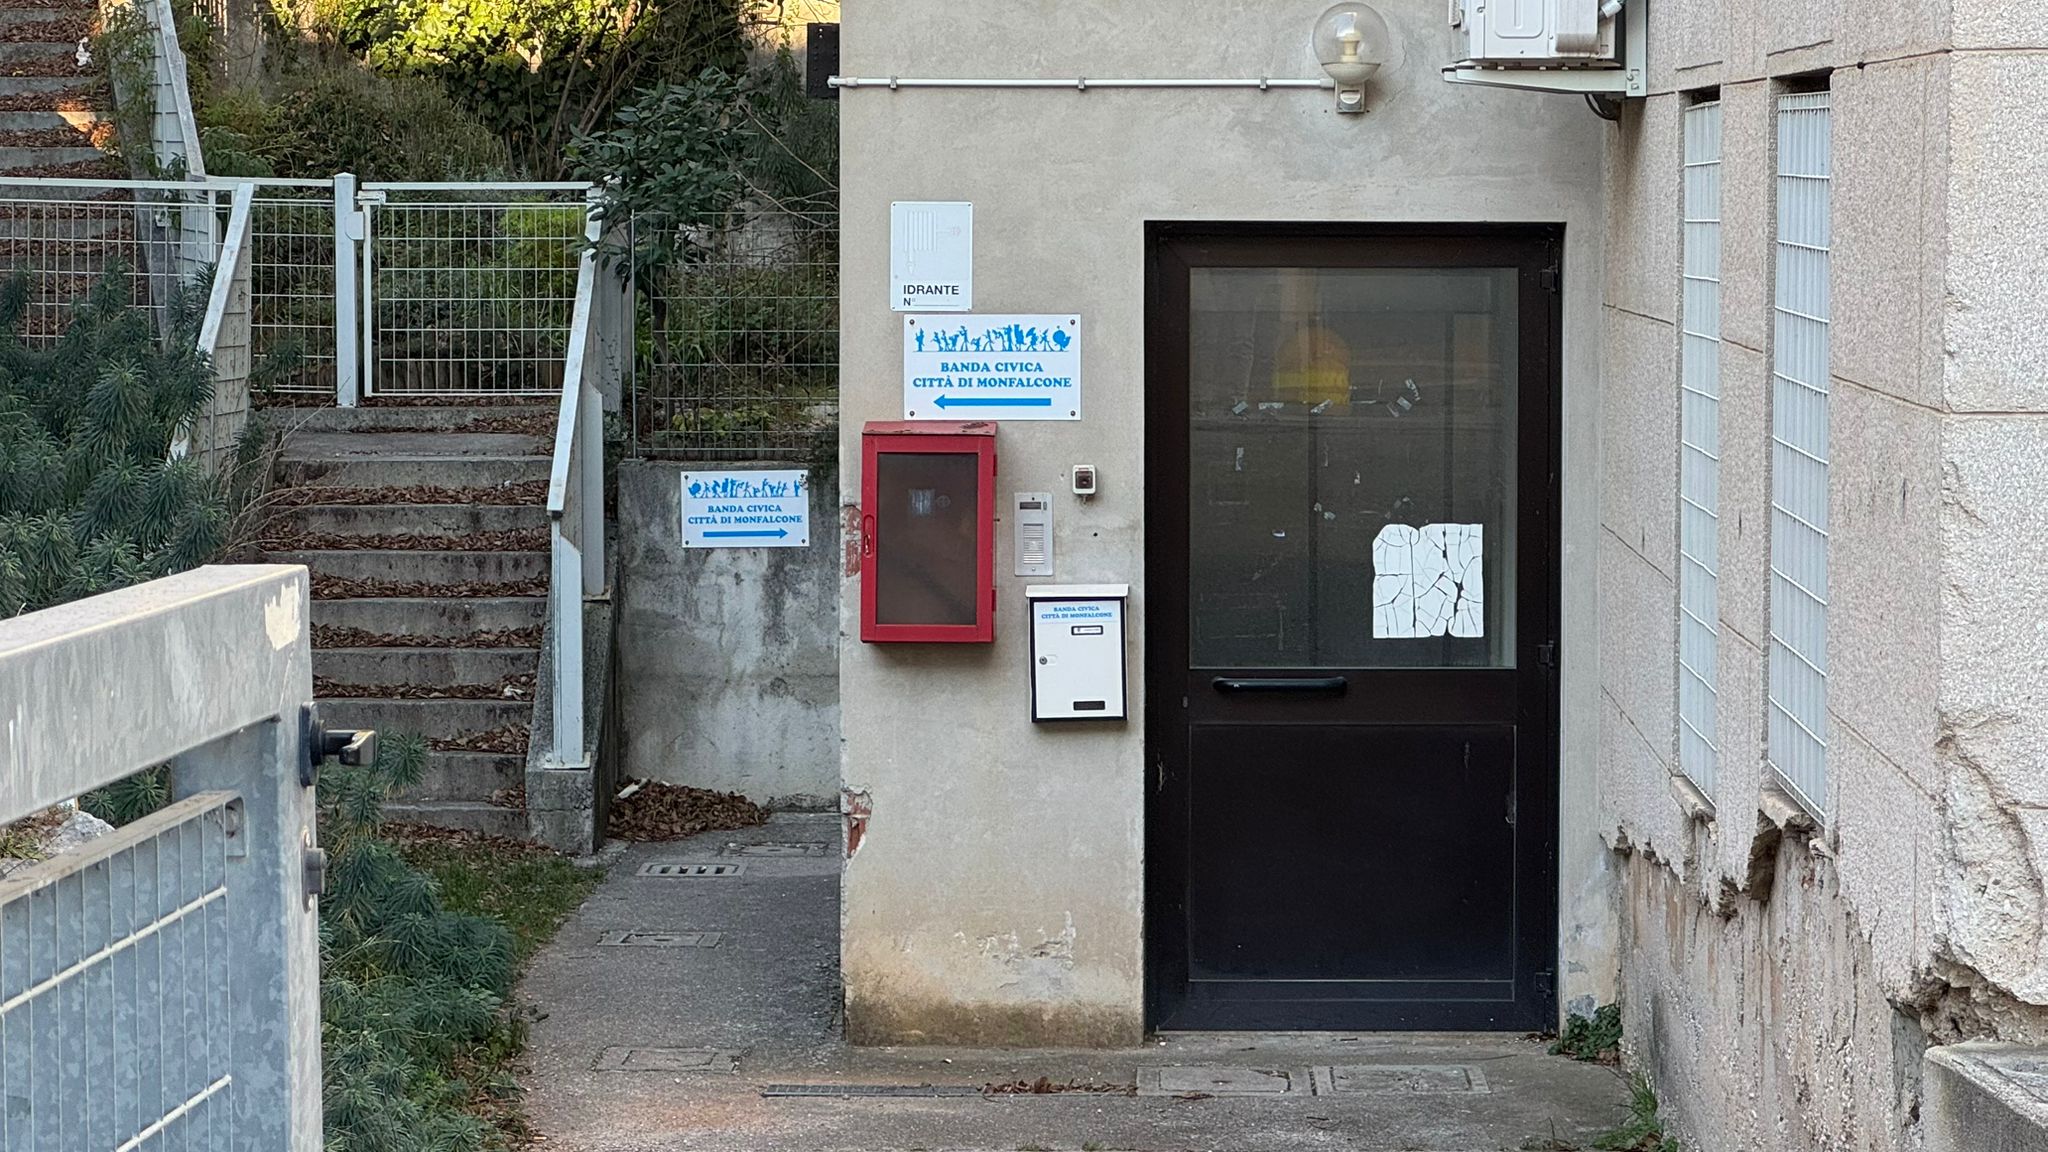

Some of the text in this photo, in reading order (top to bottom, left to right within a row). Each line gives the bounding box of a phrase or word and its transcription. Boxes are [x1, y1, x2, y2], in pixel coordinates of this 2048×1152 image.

[903, 284, 960, 295] IDRANTE
[940, 362, 1044, 373] BANDA CIVICA
[912, 374, 1072, 388] CITTÀ DI MONFALCONE
[707, 504, 782, 513] BANDA CIVICA
[688, 514, 803, 525] CITTÀ DI MONFALCONE
